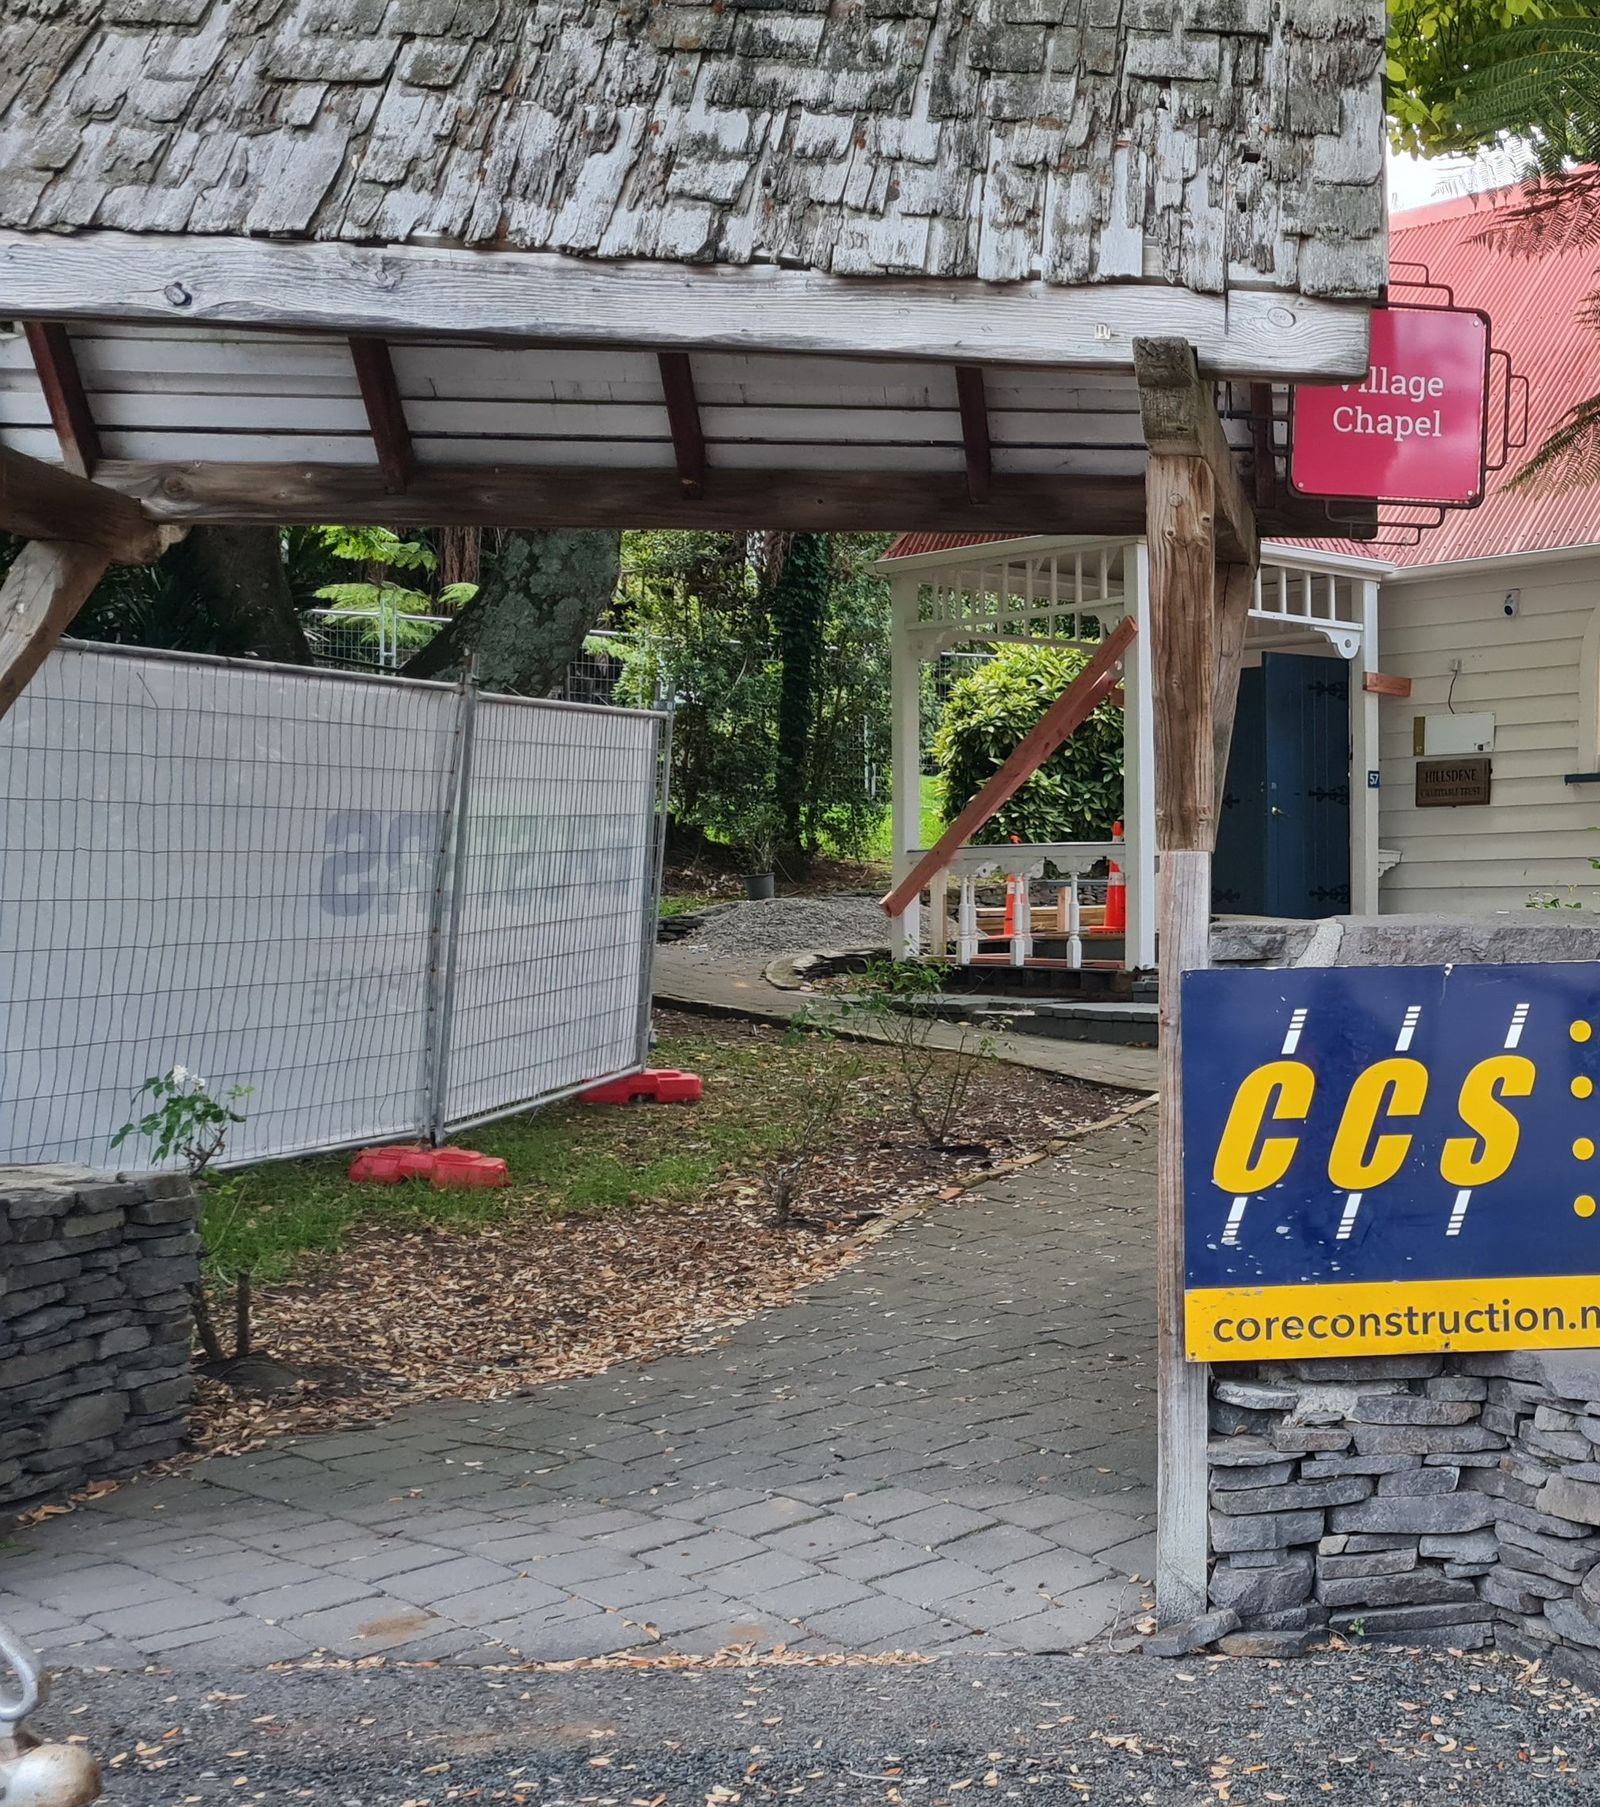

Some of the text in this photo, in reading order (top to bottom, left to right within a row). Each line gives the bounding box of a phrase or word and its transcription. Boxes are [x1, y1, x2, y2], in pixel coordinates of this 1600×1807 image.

[1333, 405, 1442, 442] Chapel
[1369, 773, 1379, 785] 57
[1212, 1055, 1536, 1194] CCS
